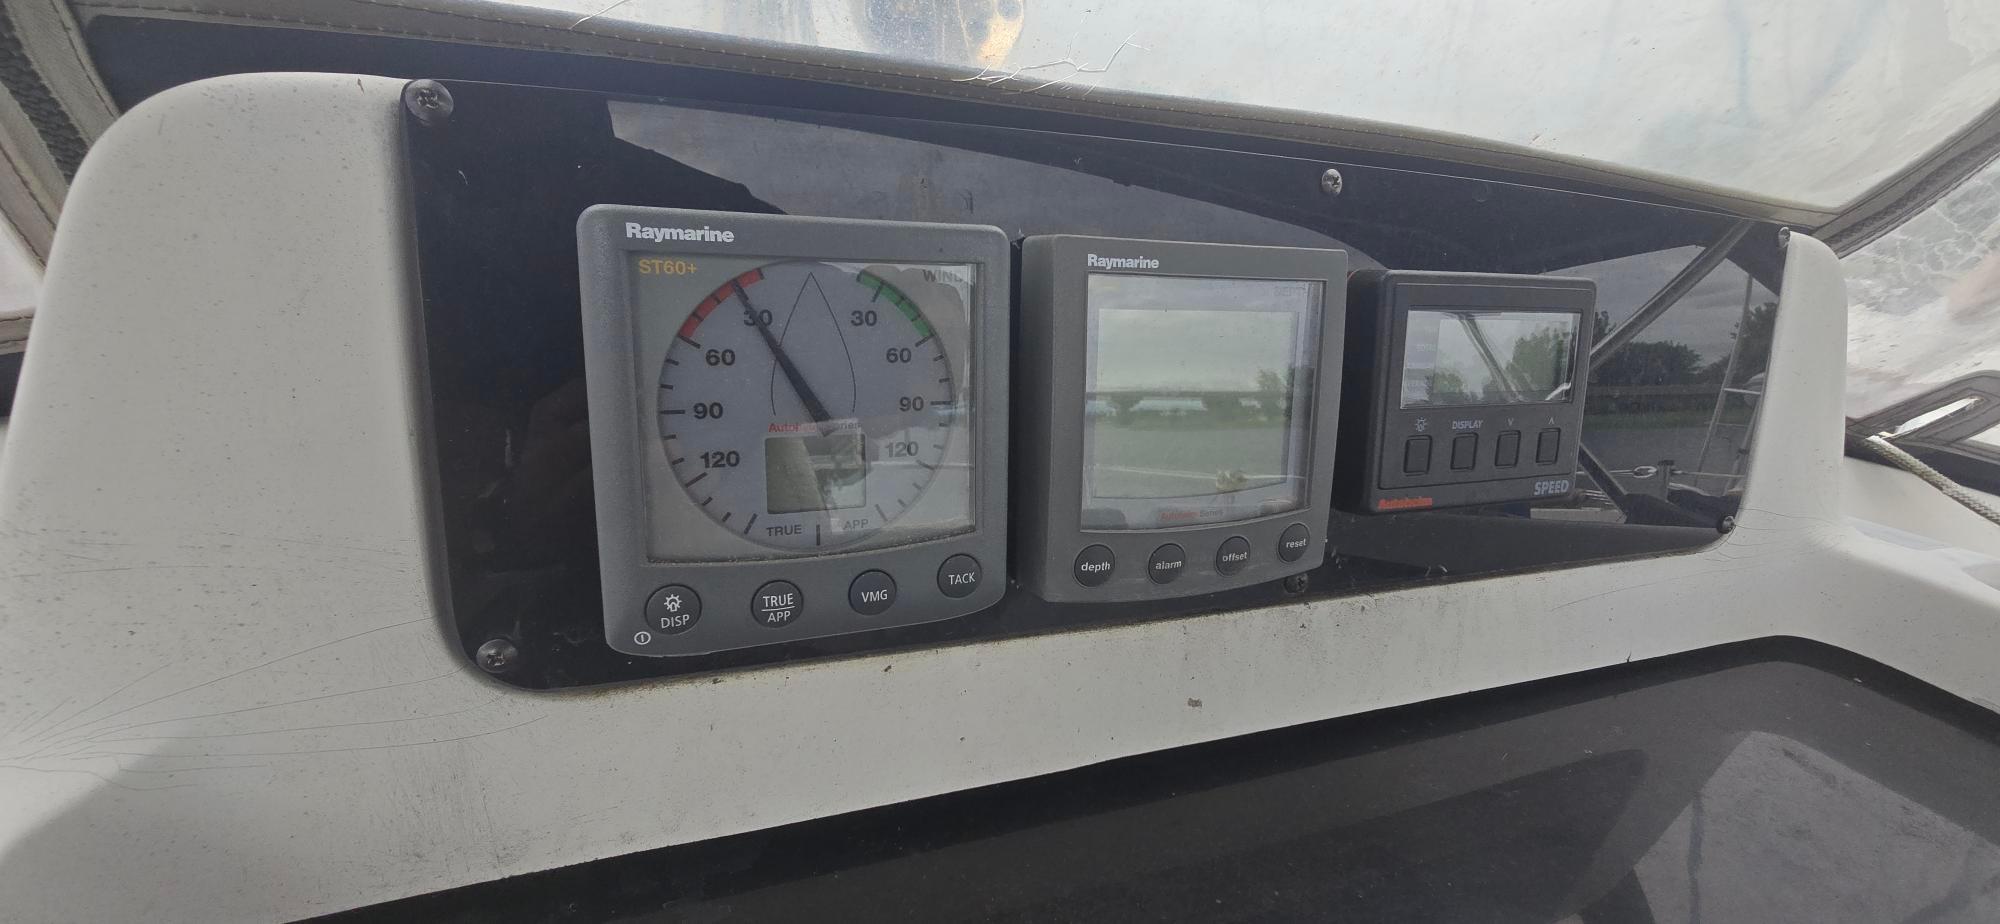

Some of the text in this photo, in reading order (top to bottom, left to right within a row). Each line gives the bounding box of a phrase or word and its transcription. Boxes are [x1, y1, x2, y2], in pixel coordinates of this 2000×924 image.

[625, 222, 735, 244] Raymarine
[638, 258, 697, 277] ST60+
[1087, 253, 1159, 270] Raymarine
[743, 308, 773, 328] 30
[850, 310, 878, 327] 30
[705, 349, 736, 367] 60
[886, 347, 912, 364] 60
[693, 402, 724, 420] 90
[899, 396, 924, 412] 90
[1452, 419, 1483, 430] DISPLAY
[885, 441, 919, 458] 120
[699, 450, 740, 469] 120
[1533, 479, 1569, 496] SPEED
[766, 524, 802, 537] TRUE
[843, 518, 869, 531] APP
[1286, 538, 1307, 549] reset
[1222, 551, 1248, 562] offset
[1081, 561, 1111, 573] depth
[1155, 559, 1182, 570] alarm
[948, 572, 976, 585] TACK
[763, 593, 794, 608] TRUE
[861, 589, 888, 603] VMG
[660, 614, 690, 629] DISP
[767, 610, 791, 623] APP
